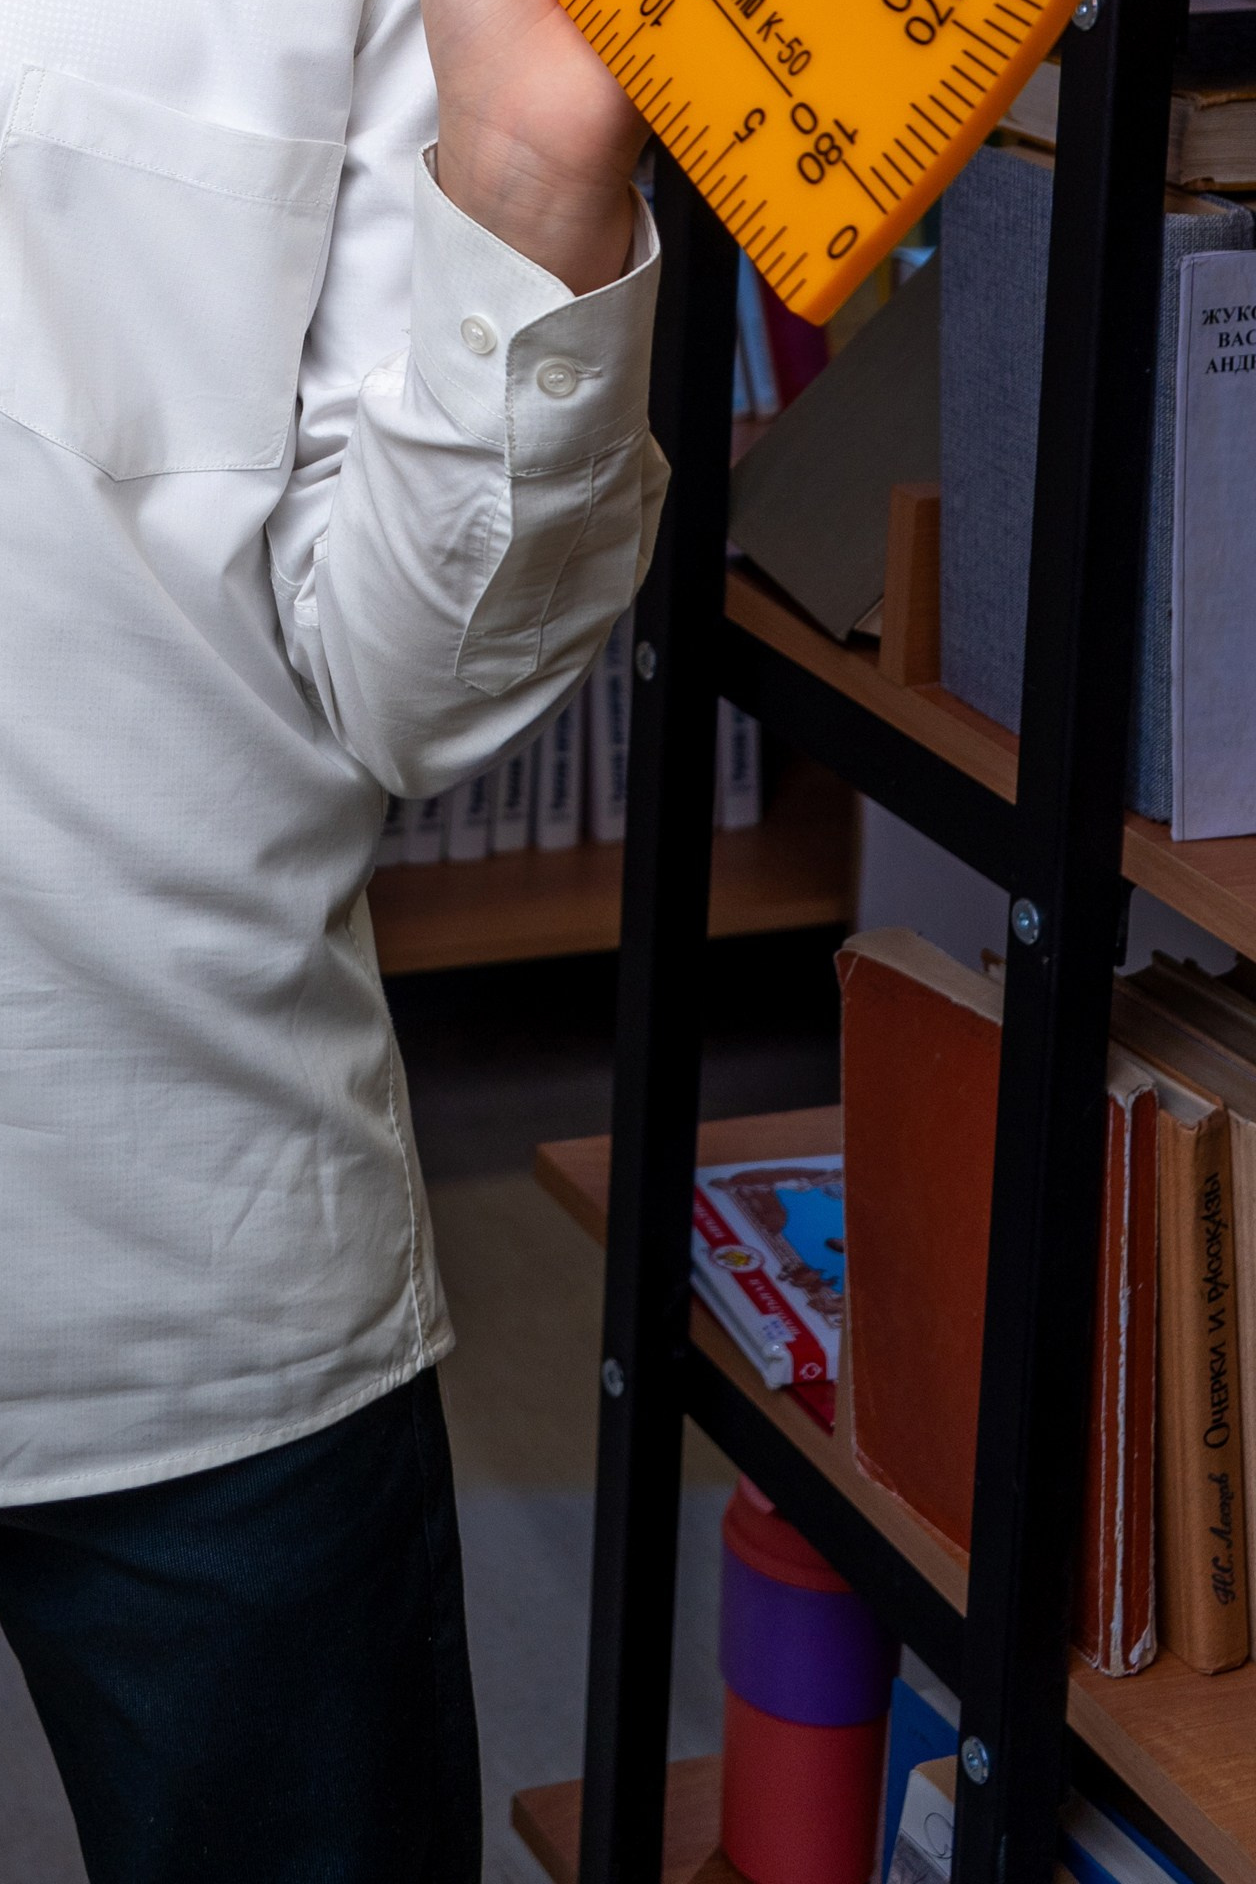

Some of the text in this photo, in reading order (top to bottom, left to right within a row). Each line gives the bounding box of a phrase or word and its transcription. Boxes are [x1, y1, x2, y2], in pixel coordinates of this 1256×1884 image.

[756, 11, 812, 77] K-50
[733, 107, 766, 144] 5
[790, 101, 819, 136] 0
[796, 115, 860, 186] 180
[826, 224, 859, 261] 0
